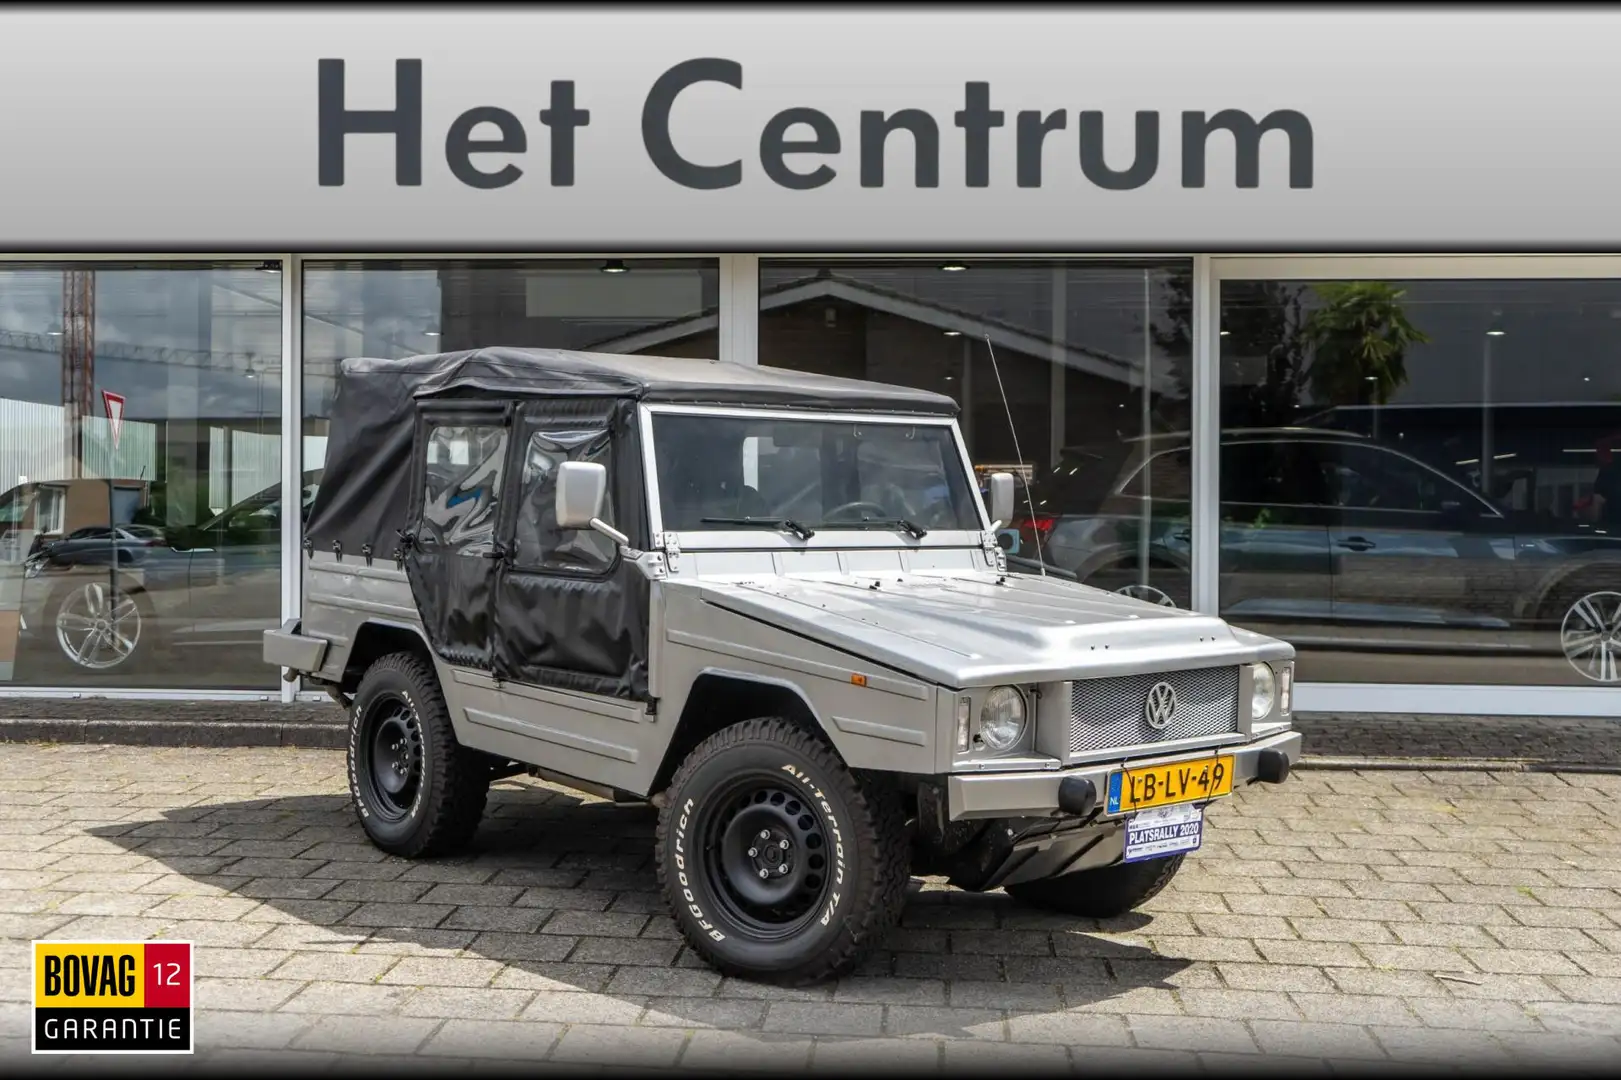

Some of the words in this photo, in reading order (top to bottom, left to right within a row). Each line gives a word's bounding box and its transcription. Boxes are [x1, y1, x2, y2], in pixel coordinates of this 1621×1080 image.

[1129, 763, 1224, 803] LB-LV-49
[1109, 797, 1119, 806] NL
[1180, 822, 1199, 836] 2020
[674, 798, 727, 942] BFGoodrich
